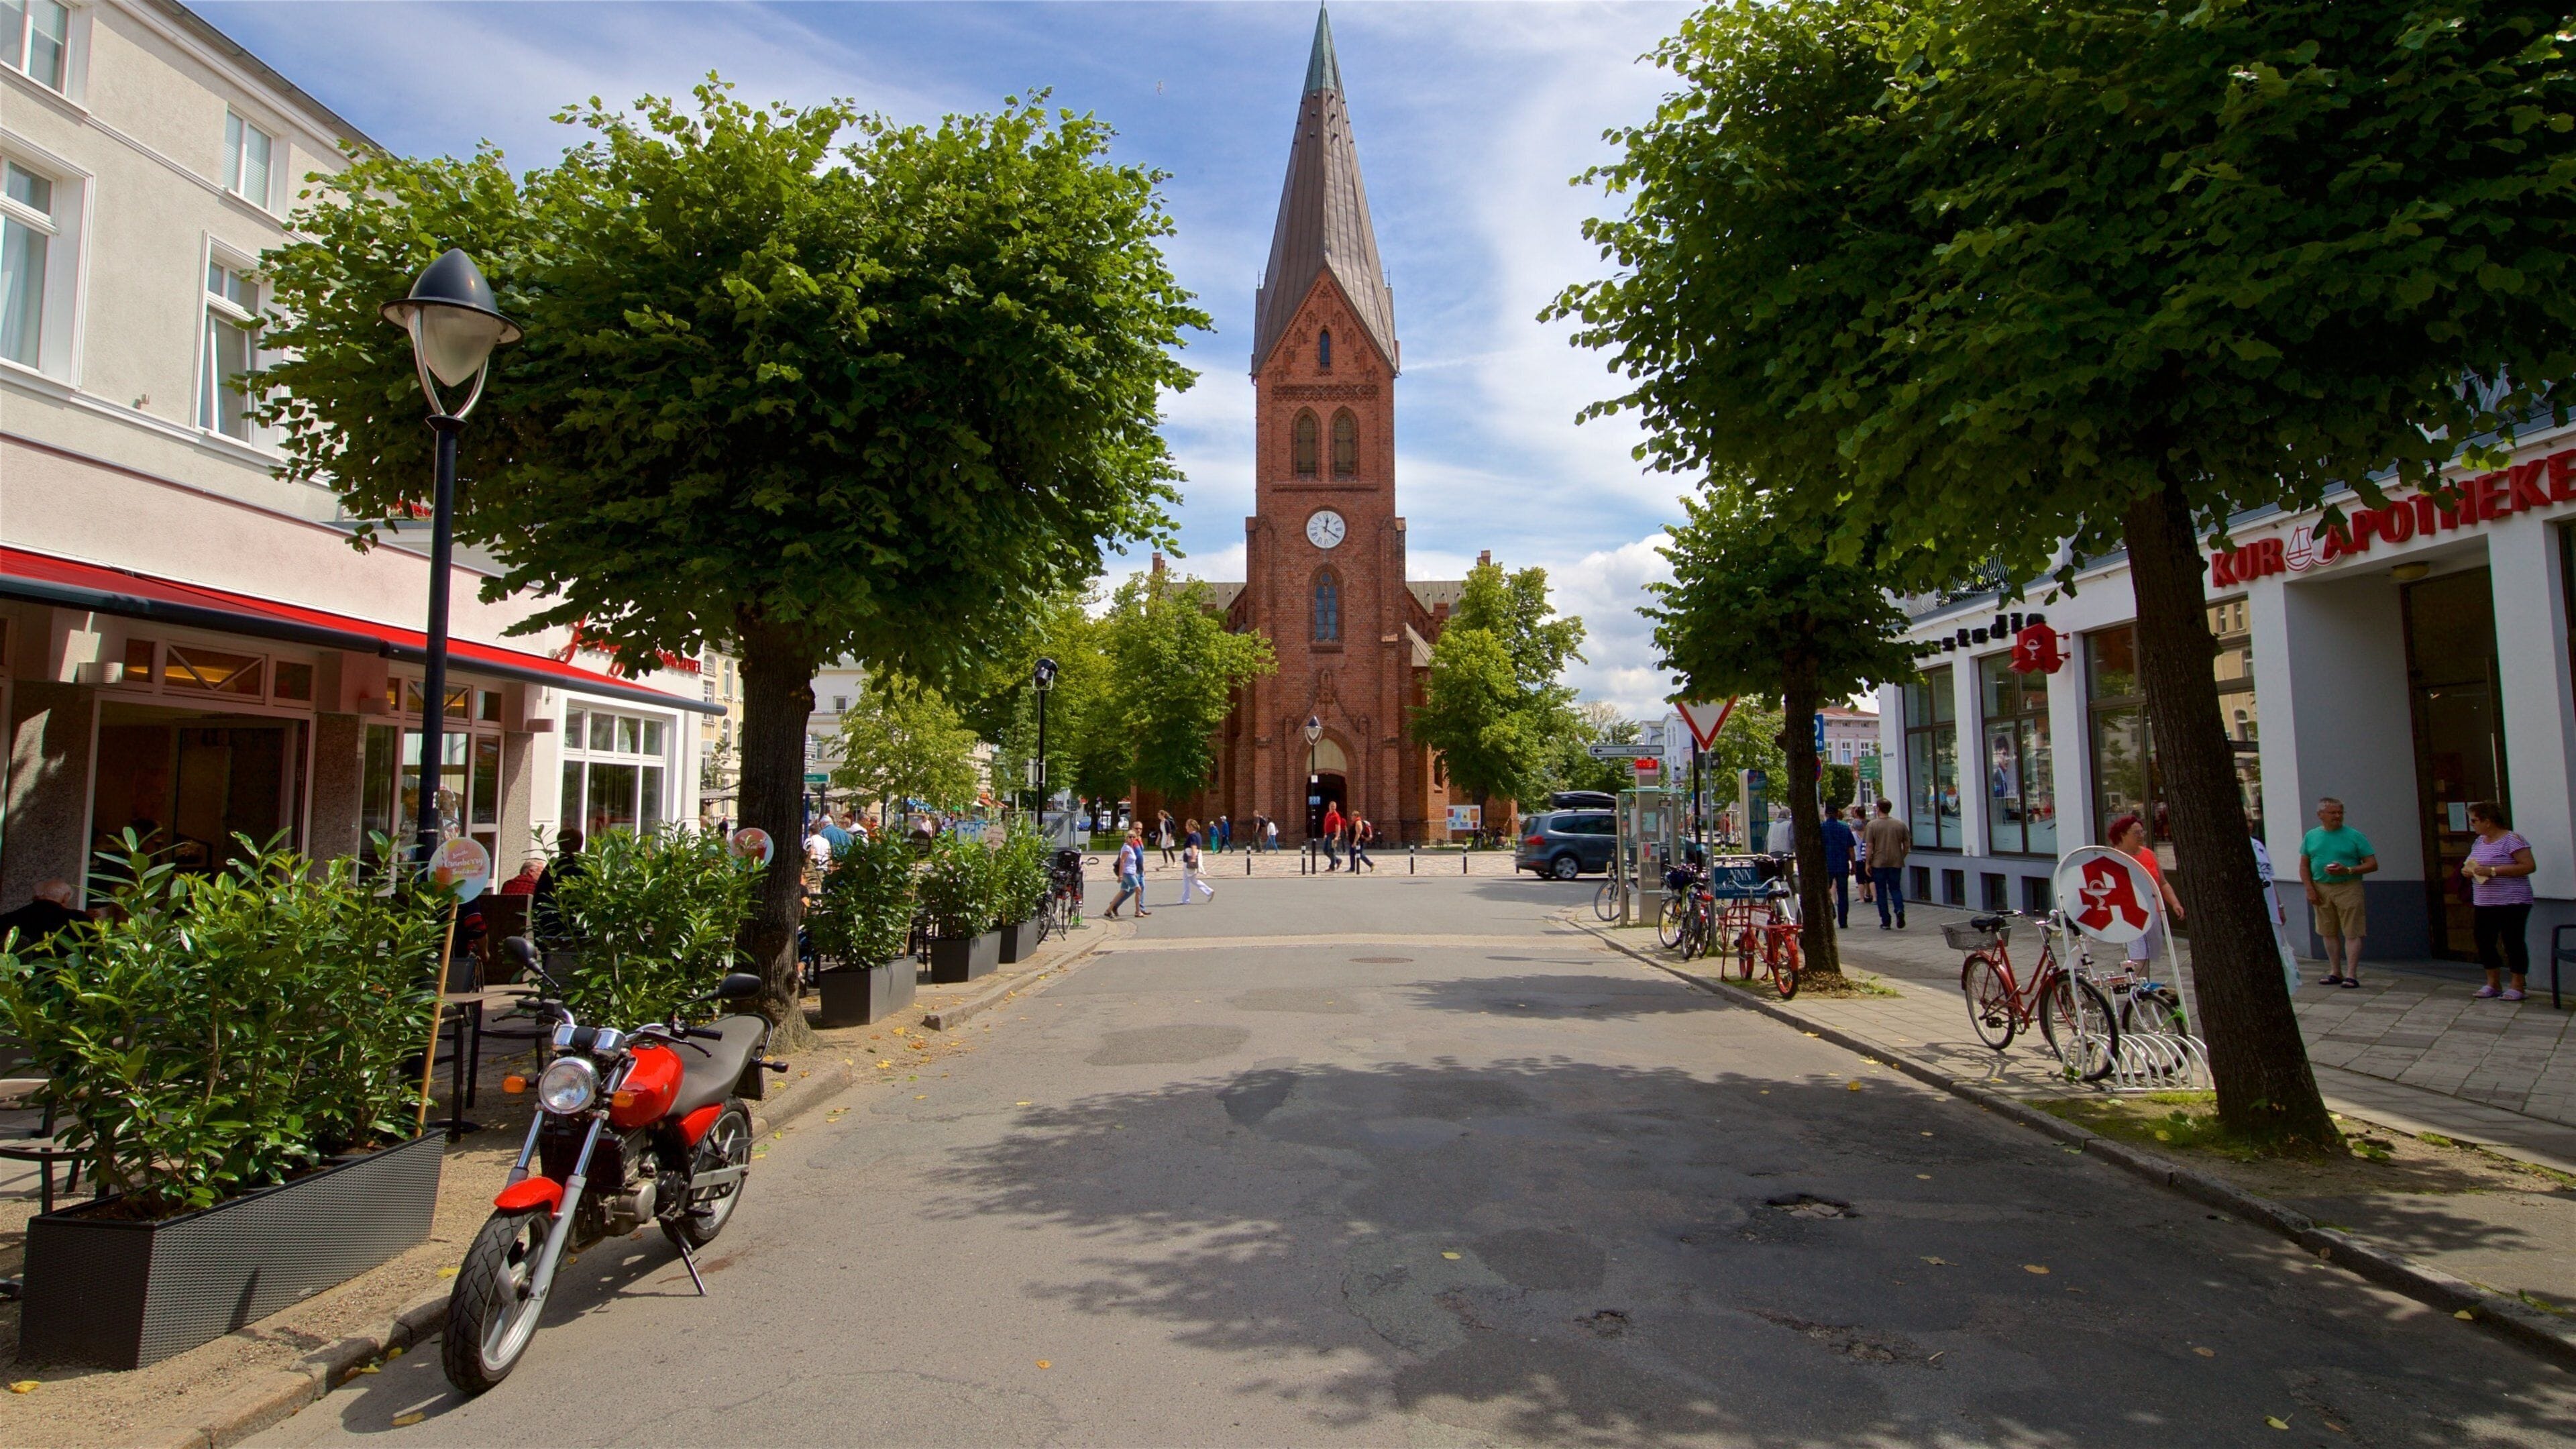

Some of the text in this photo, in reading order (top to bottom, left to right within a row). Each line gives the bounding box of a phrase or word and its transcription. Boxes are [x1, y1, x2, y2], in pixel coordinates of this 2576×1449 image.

[2211, 449, 2576, 588] KUR APOTHEKE
[1729, 869, 1752, 881] NNN
